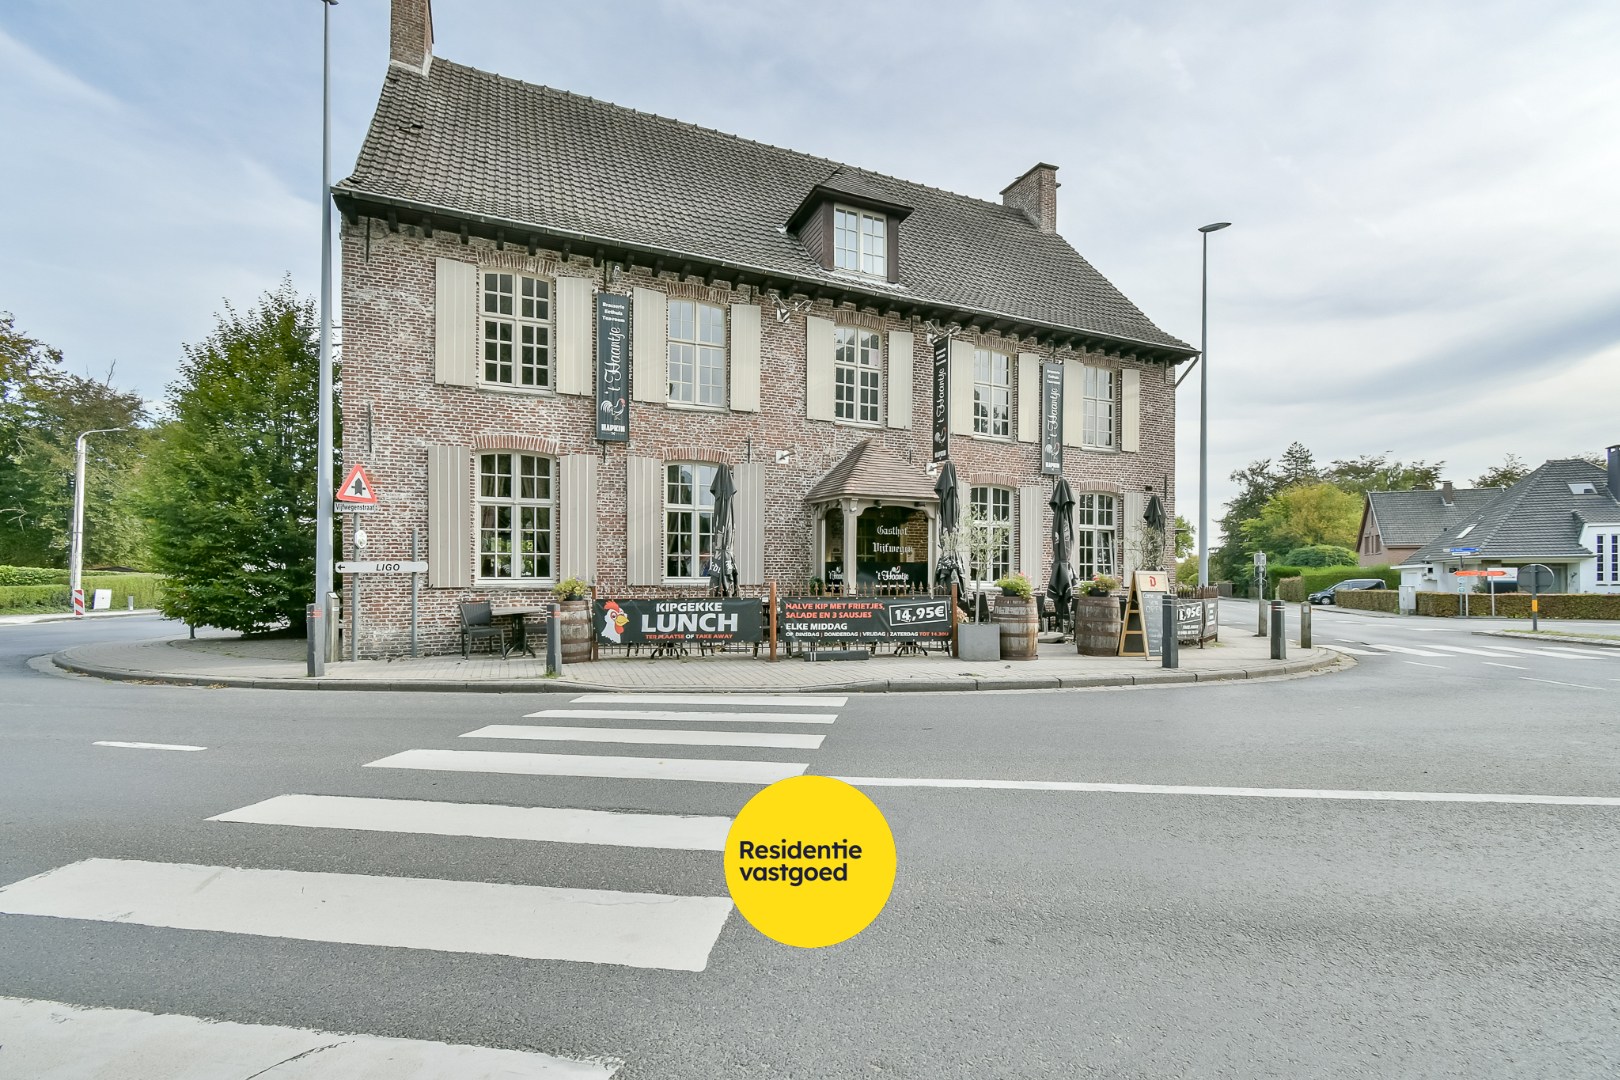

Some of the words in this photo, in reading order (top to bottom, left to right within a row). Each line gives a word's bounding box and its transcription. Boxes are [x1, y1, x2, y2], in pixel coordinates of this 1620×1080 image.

[604, 327, 626, 384] Haantje
[876, 526, 909, 537] Gasthof
[376, 563, 401, 572] LIGO
[656, 602, 723, 612] KIPGEKKE
[848, 603, 885, 611] FRIETJES,
[785, 611, 818, 619] SALADE
[819, 611, 831, 619] EN
[831, 611, 838, 619] 3
[838, 611, 872, 619] SAUSJES
[895, 605, 945, 623] 14,95€
[641, 613, 739, 633] LUNCH
[785, 622, 809, 631] ELKE
[810, 622, 849, 631] MIDDAG
